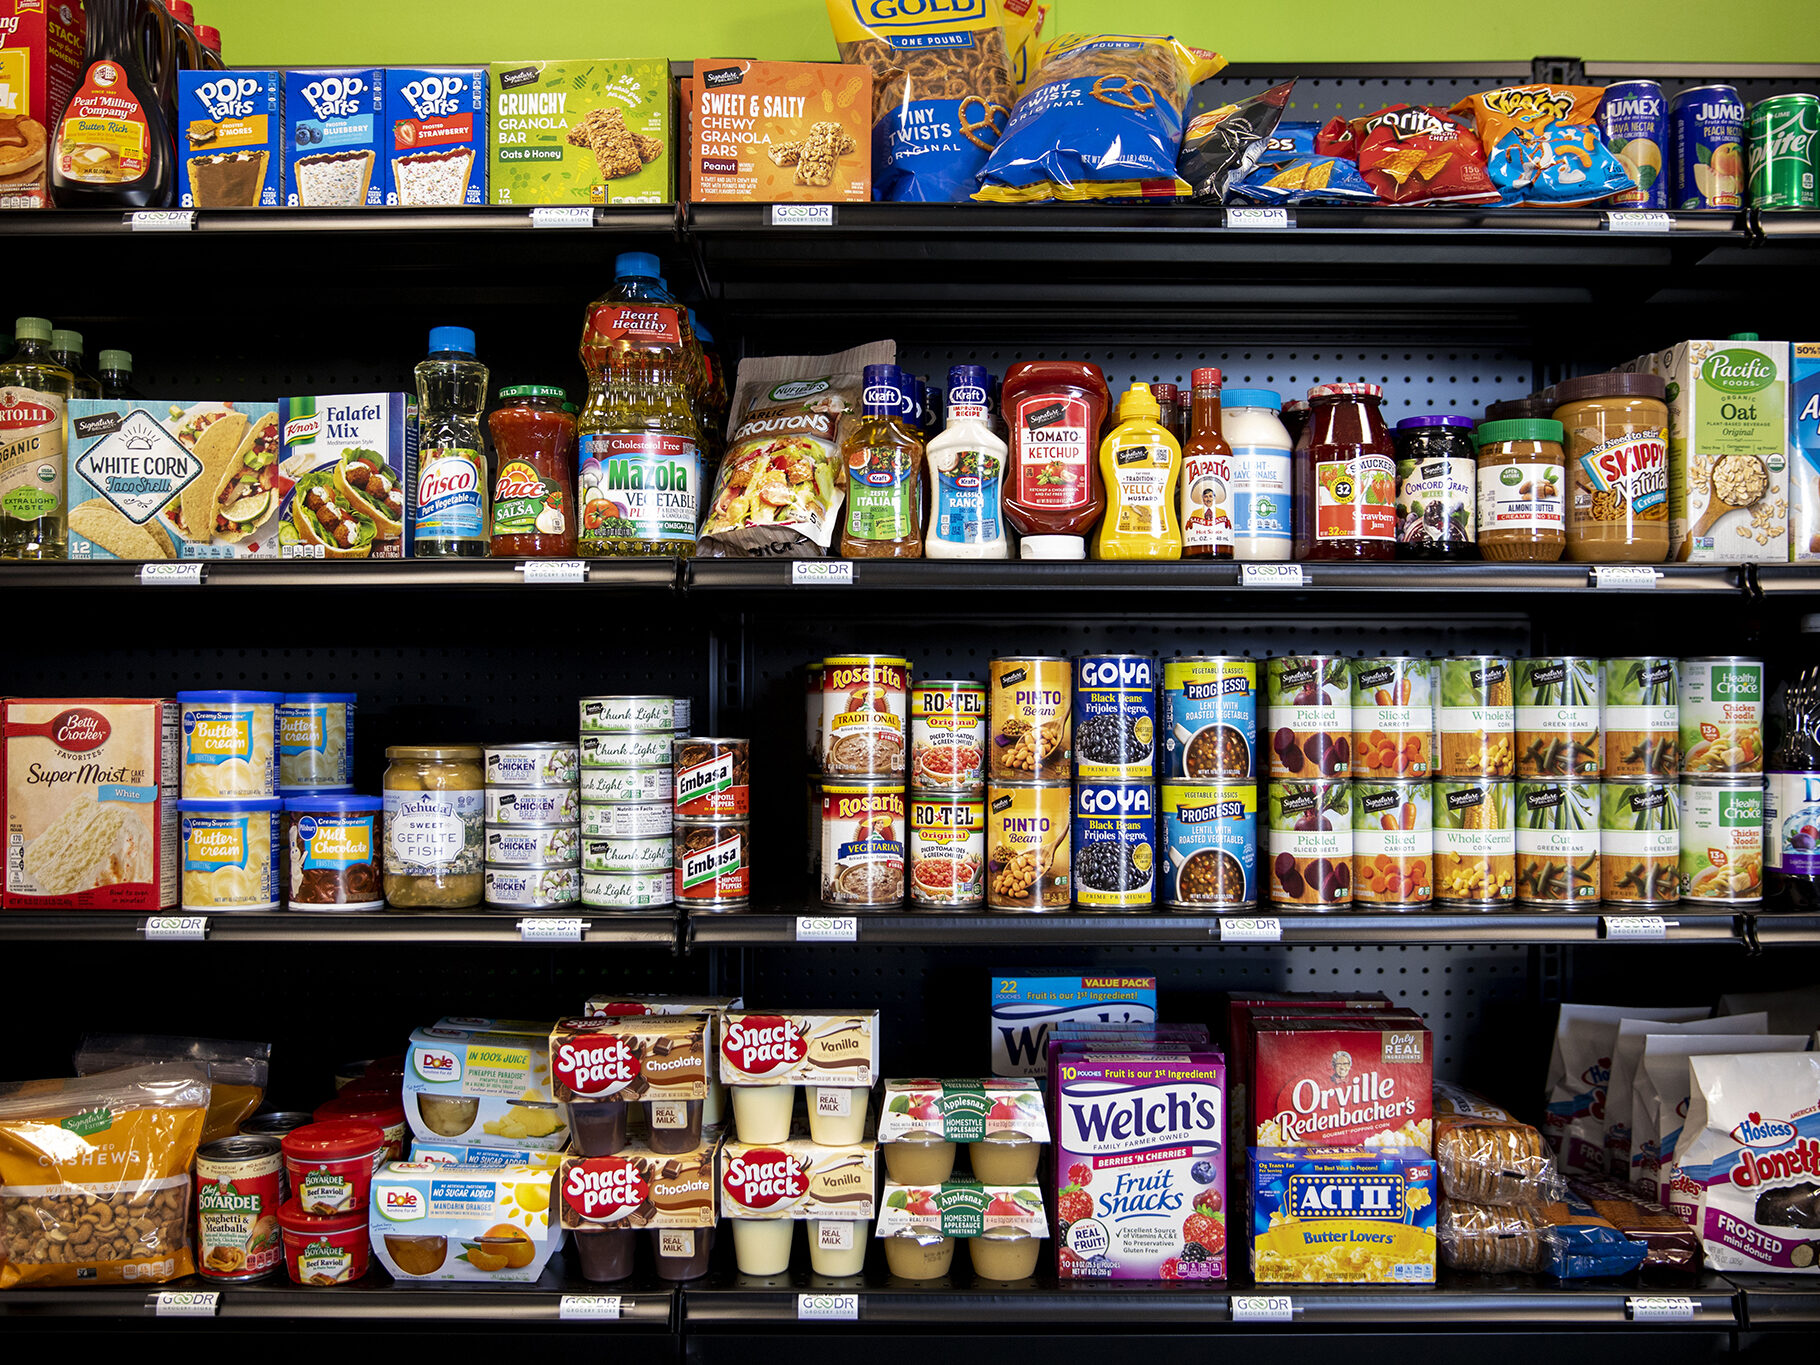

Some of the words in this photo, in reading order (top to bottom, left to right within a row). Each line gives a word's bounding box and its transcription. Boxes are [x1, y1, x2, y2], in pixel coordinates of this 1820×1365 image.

[928, 36, 962, 44] POUND
[74, 97, 99, 108] Pearl
[101, 97, 138, 111] Milling
[498, 92, 568, 116] CRUNCHY
[701, 92, 745, 117] SWEET
[764, 96, 806, 119] SALTY
[1601, 100, 1659, 119] JUMEX
[80, 106, 130, 119] Company
[79, 121, 105, 131] Butter
[108, 122, 128, 133] Rich
[323, 124, 369, 135] BLUEBERRY
[498, 118, 568, 130] GRANOLA
[701, 117, 755, 130] CHEWY
[1631, 122, 1654, 133] NECTAR
[219, 126, 252, 137] S'MORES
[419, 127, 469, 138] STRAWBERRY
[498, 132, 527, 144] BAR
[701, 131, 771, 144] GRANOLA
[1704, 127, 1725, 136] PEACH
[500, 149, 521, 160] Oats
[523, 149, 530, 159] &
[532, 149, 561, 161] Honey
[701, 144, 737, 157] BARS
[703, 161, 736, 171] Peanut
[499, 189, 510, 200] 12
[619, 310, 659, 321] Heart
[612, 318, 667, 332] Healthy
[1709, 355, 1771, 379] Pacific
[540, 388, 565, 396] MILD
[869, 390, 895, 401] Kraft
[955, 389, 981, 402] Kraft
[326, 404, 381, 422] Falafel
[953, 406, 983, 414] IMPROVED
[1721, 403, 1757, 421] Oat
[287, 419, 319, 439] Knorr
[326, 423, 359, 439] Mix
[1722, 427, 1754, 437] Original
[1029, 431, 1079, 442] TOMATO
[662, 440, 680, 450] Free
[1028, 446, 1079, 459] KETCHUP
[90, 457, 139, 475] WHITE
[144, 457, 187, 478] CORN
[1600, 442, 1665, 482] SKIPPY
[608, 460, 687, 491] Mazola
[139, 477, 172, 493] Shells
[495, 478, 544, 498] Pace
[1336, 484, 1350, 494] 32
[1405, 482, 1444, 495] CONCORD
[422, 503, 436, 515] Pure
[435, 493, 469, 509] Vegetable
[496, 506, 535, 520] SALSA
[1372, 521, 1384, 529] Jam
[832, 665, 901, 689] Rosarita
[1082, 662, 1149, 686] GOYA
[1716, 682, 1758, 694] Choice
[1091, 693, 1115, 703] Black
[1022, 704, 1055, 717] Beans
[1085, 703, 1118, 714] Frijoles
[1723, 704, 1756, 712] Chicken
[1186, 710, 1212, 720] ROASTED
[1379, 710, 1409, 720] Sliced
[1558, 710, 1576, 720] Cut
[1725, 712, 1754, 720] Noodle
[67, 715, 98, 731] Betty
[58, 727, 103, 742] Crocker
[498, 762, 535, 772] CHICKEN
[679, 766, 728, 794] Embasa
[115, 788, 140, 798] White
[1081, 789, 1148, 812] GOYA
[404, 802, 450, 816] Yehuda
[1003, 818, 1049, 832] PINTO
[319, 827, 346, 840] Milk
[398, 832, 456, 843] GEFILTE
[1448, 834, 1481, 843] Whole
[314, 840, 367, 854] Chocolate
[408, 845, 444, 856] FISH
[848, 844, 900, 853] VEGETARIAN
[1001, 981, 1017, 993] 22
[1085, 979, 1117, 988] VALUE
[1120, 979, 1150, 988] PACK
[1027, 991, 1048, 1000] Fruit
[1090, 991, 1137, 1001] Ingredient!
[820, 1038, 859, 1052] Vanilla
[1391, 1035, 1415, 1047] Only
[424, 1054, 453, 1068] Dole
[469, 1053, 477, 1062] IN
[479, 1053, 501, 1062] 100%
[503, 1053, 527, 1064] JUICE
[558, 1040, 632, 1069] Snack
[646, 1056, 702, 1071] Chocolate
[576, 1058, 632, 1088] pack
[1062, 1067, 1076, 1079] 10
[1105, 1069, 1127, 1079] Fruit
[1292, 1072, 1394, 1114] Orville
[944, 1096, 985, 1111] Applesnax
[656, 1109, 674, 1117] REAL
[1069, 1092, 1216, 1142] Welch's
[1277, 1096, 1415, 1142] Redenbacher's
[656, 1116, 675, 1124] MILK
[1741, 1118, 1791, 1142] Hostess
[1094, 1143, 1120, 1151] FAMILY
[1123, 1139, 1156, 1148] FARMER
[1159, 1133, 1189, 1142] OWNED
[38, 1151, 139, 1167] CASHEWS
[1098, 1155, 1132, 1168] BERRIES
[1145, 1149, 1186, 1162] CHERRIES
[822, 1173, 861, 1186] Vanilla
[1410, 1168, 1418, 1180] 3
[307, 1188, 324, 1196] Beef
[325, 1187, 343, 1196] Ravioli
[432, 1188, 445, 1197] NO
[446, 1188, 470, 1198] SUGAR
[472, 1189, 494, 1199] ADDED
[1300, 1185, 1355, 1209] ACT
[1098, 1190, 1184, 1218] Snacks
[204, 1214, 240, 1225] Spaghetti
[206, 1222, 247, 1233] Meatballs
[1718, 1215, 1782, 1252] FROSTED
[1074, 1237, 1105, 1250] FRUIT!
[1349, 1230, 1393, 1244] Lovers
[1723, 1233, 1741, 1246] mini
[1743, 1244, 1772, 1262] donuts
